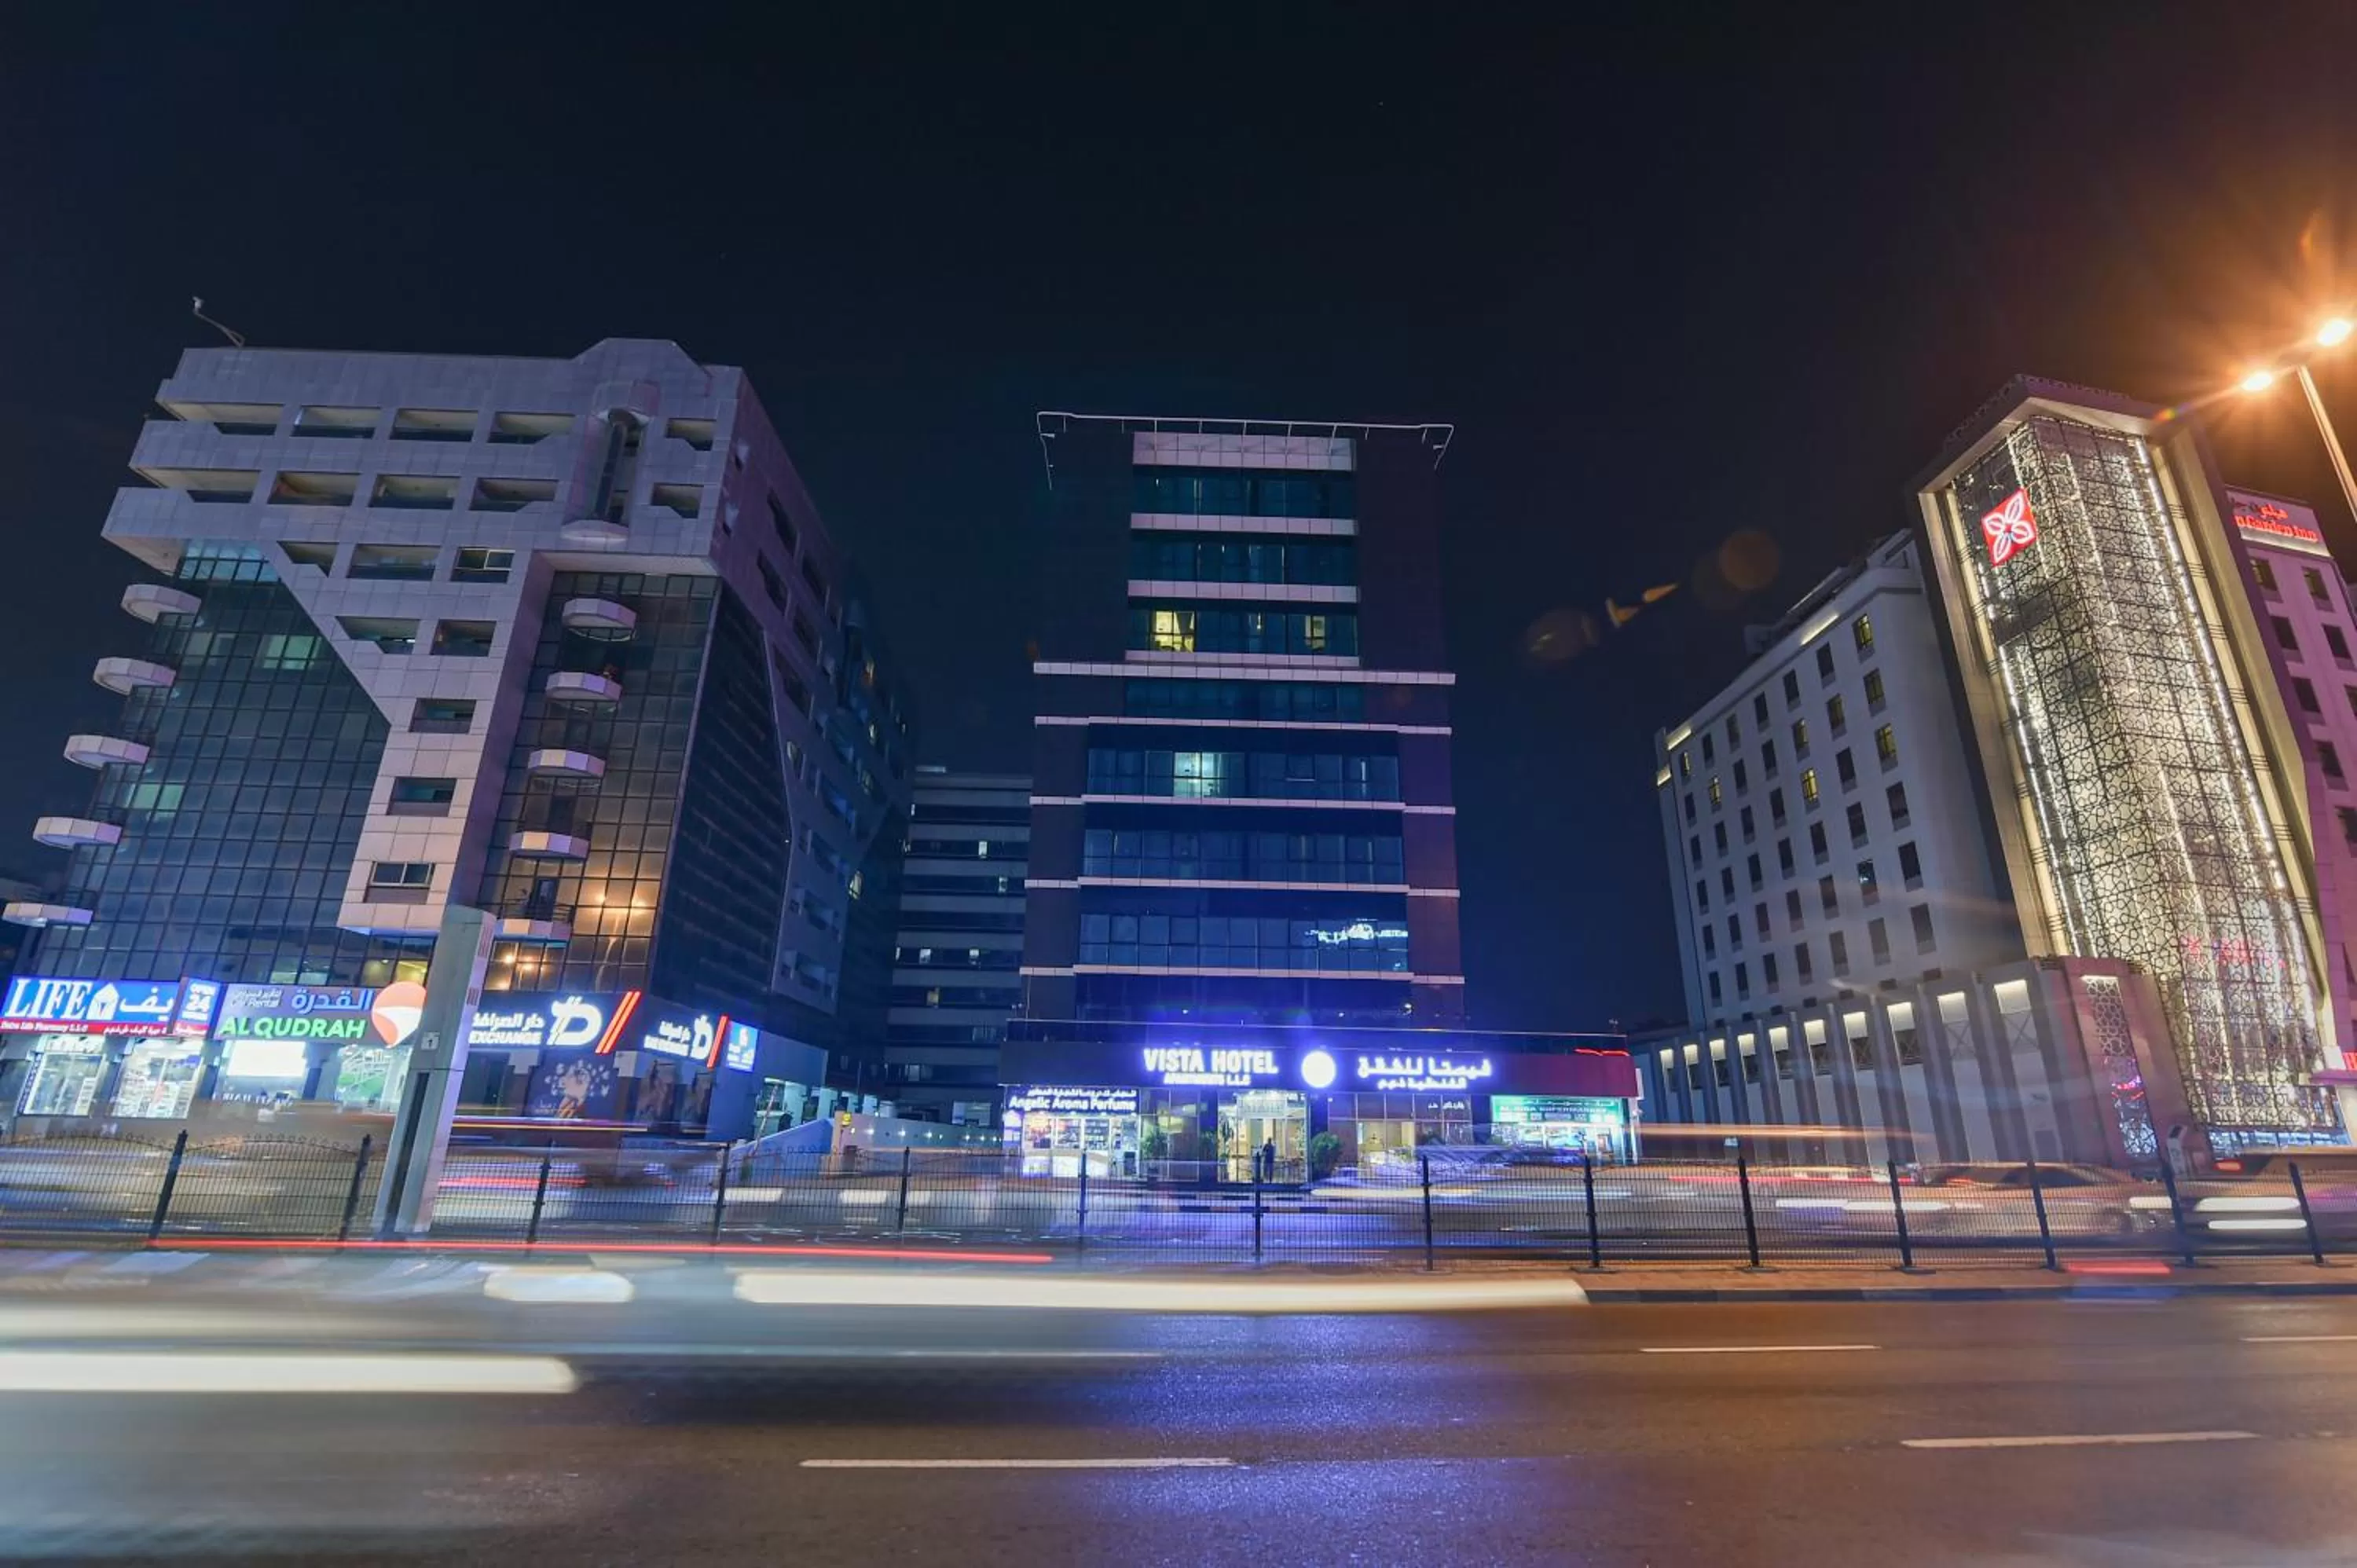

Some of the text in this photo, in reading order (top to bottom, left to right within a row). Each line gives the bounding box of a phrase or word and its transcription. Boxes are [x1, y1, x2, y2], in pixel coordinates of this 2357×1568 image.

[4, 979, 93, 1019] LIFE
[185, 995, 211, 1013] 24
[291, 989, 374, 1014] القدرة
[219, 1017, 251, 1035] AL
[254, 1017, 367, 1039] QUDRAH
[468, 1031, 542, 1045] EXCHANGE
[1143, 1047, 1279, 1074] VISTA HOTEL
[1009, 1096, 1137, 1111] Angelic Aroma Perfume
